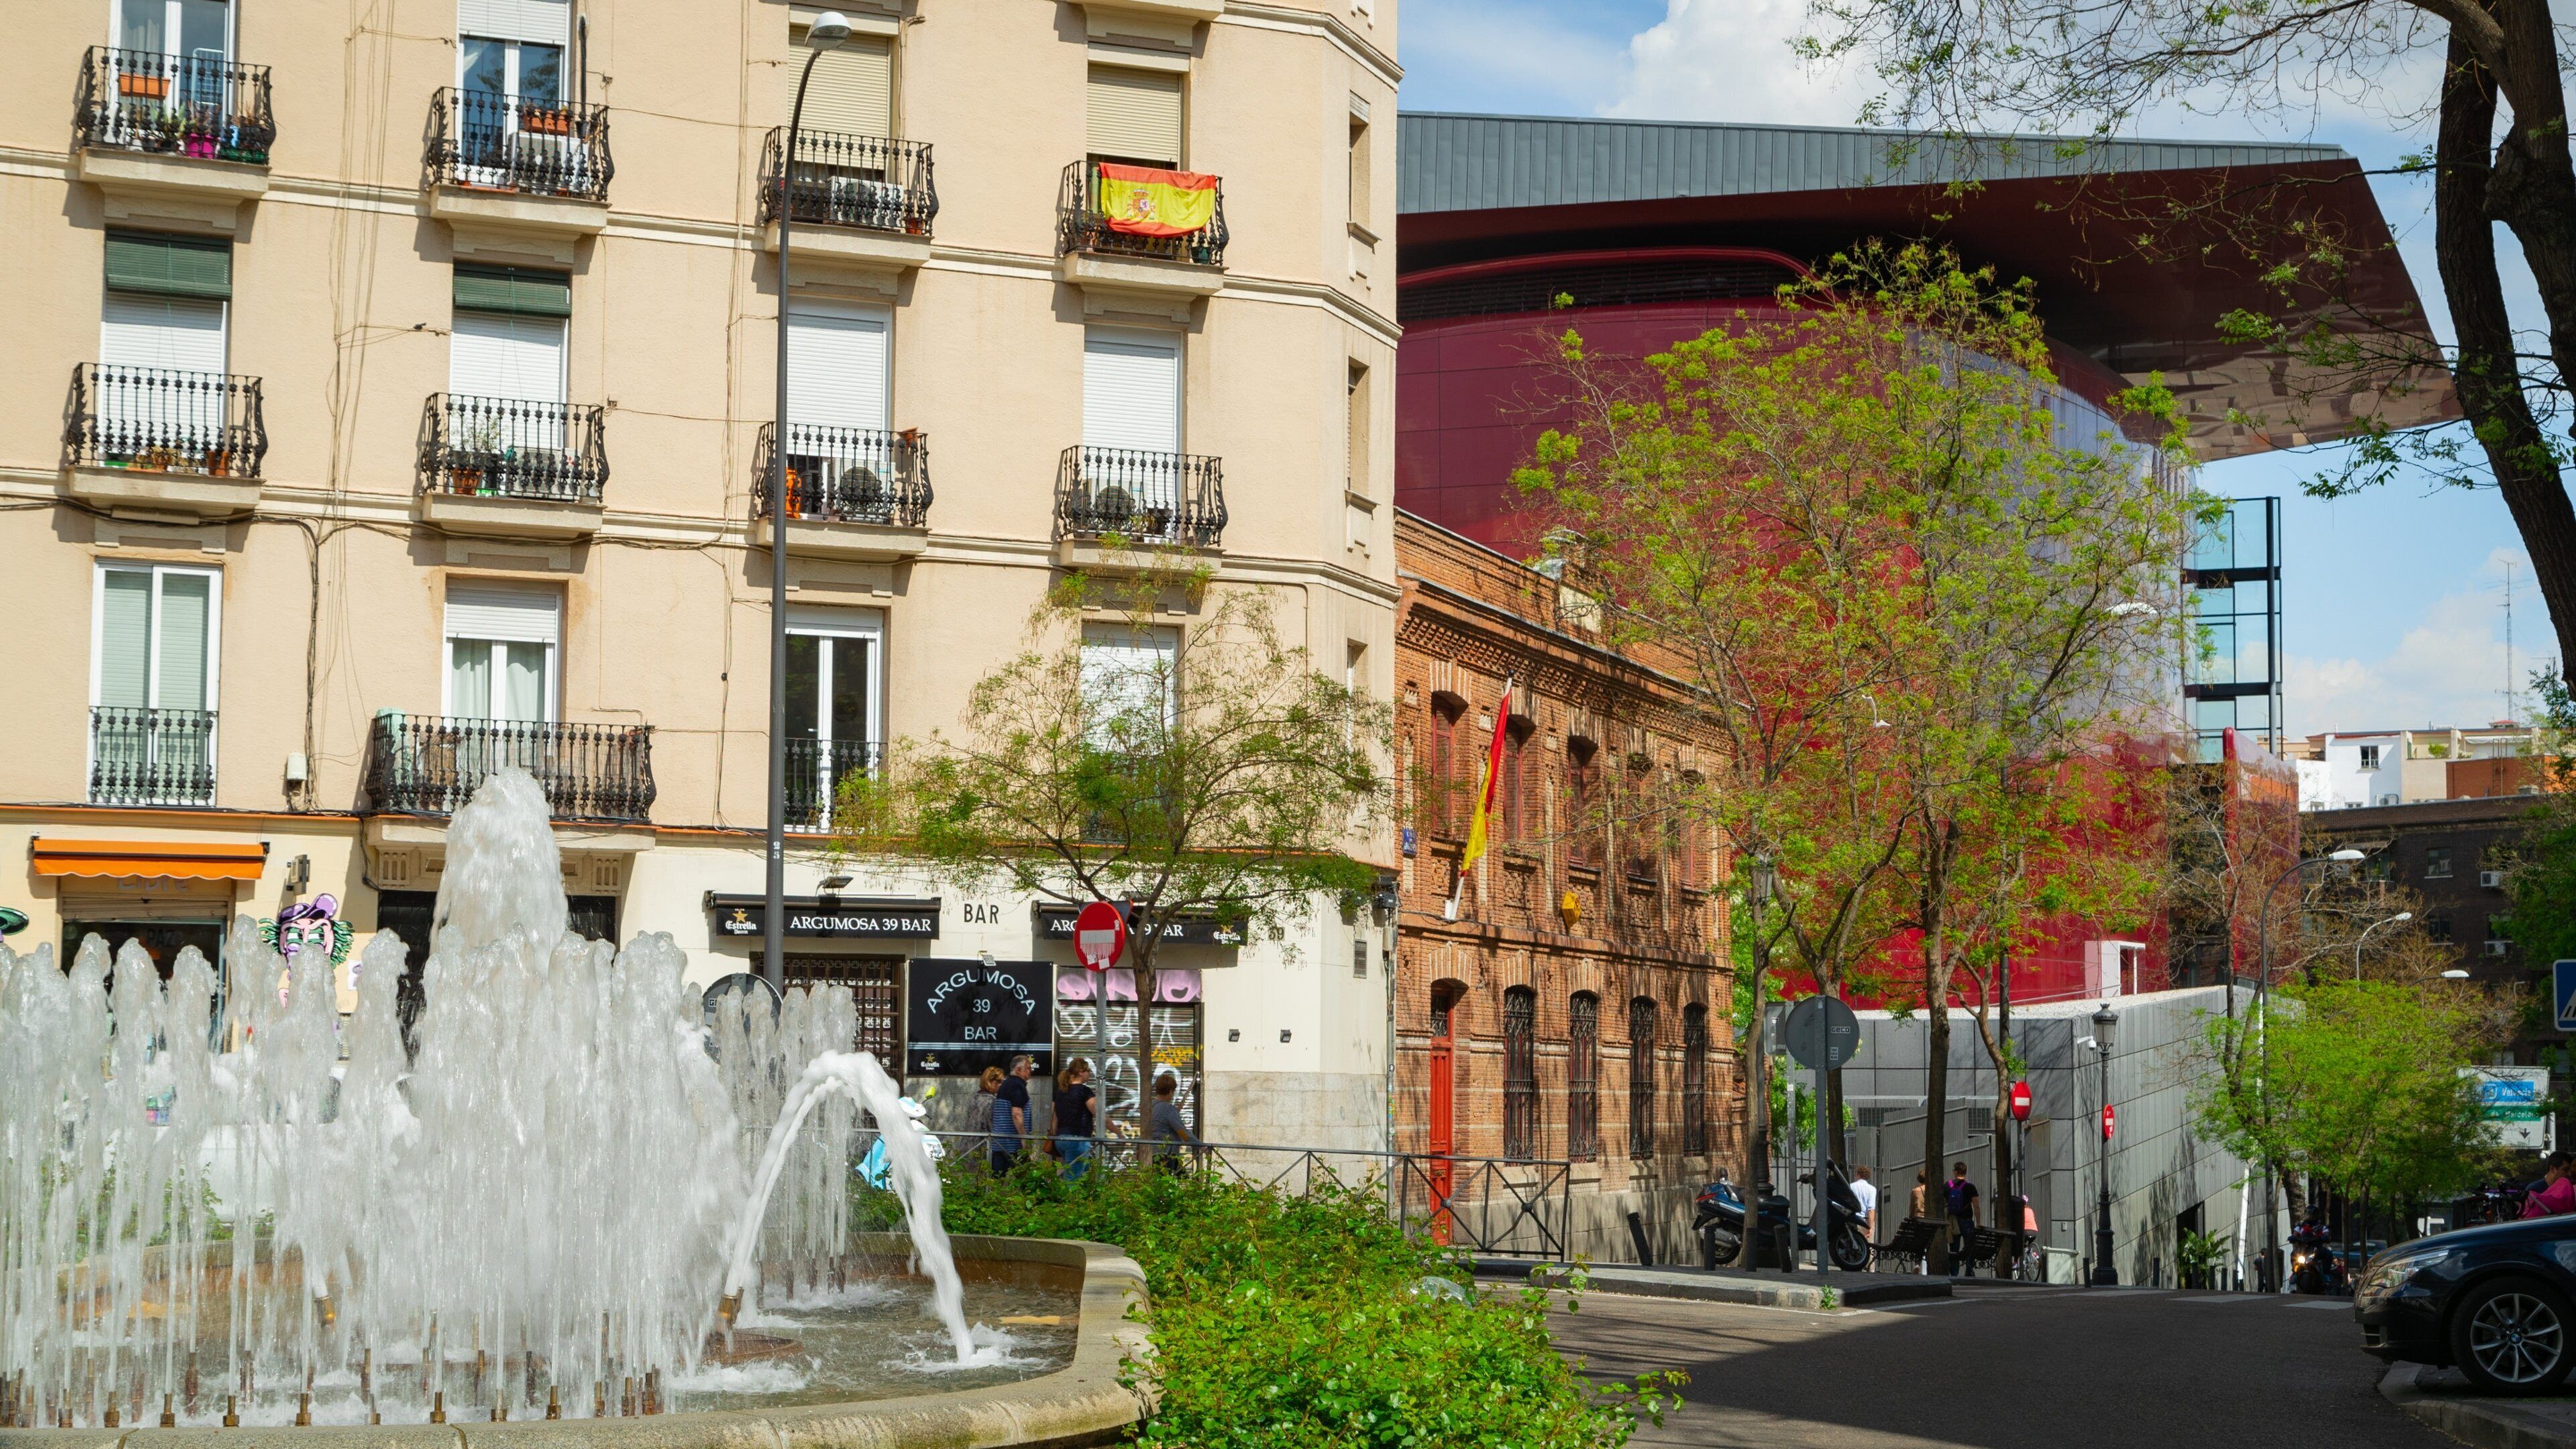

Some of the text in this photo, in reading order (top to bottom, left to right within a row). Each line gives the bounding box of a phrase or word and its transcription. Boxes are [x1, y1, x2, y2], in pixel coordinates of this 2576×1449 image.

[964, 903, 999, 924] BAR
[725, 920, 757, 930] Estrella
[790, 916, 932, 932] ARGUMOSA 39 BAR
[926, 969, 1036, 1016] ARGUMOSA
[973, 999, 990, 1013] 39
[965, 1026, 997, 1040] BAR
